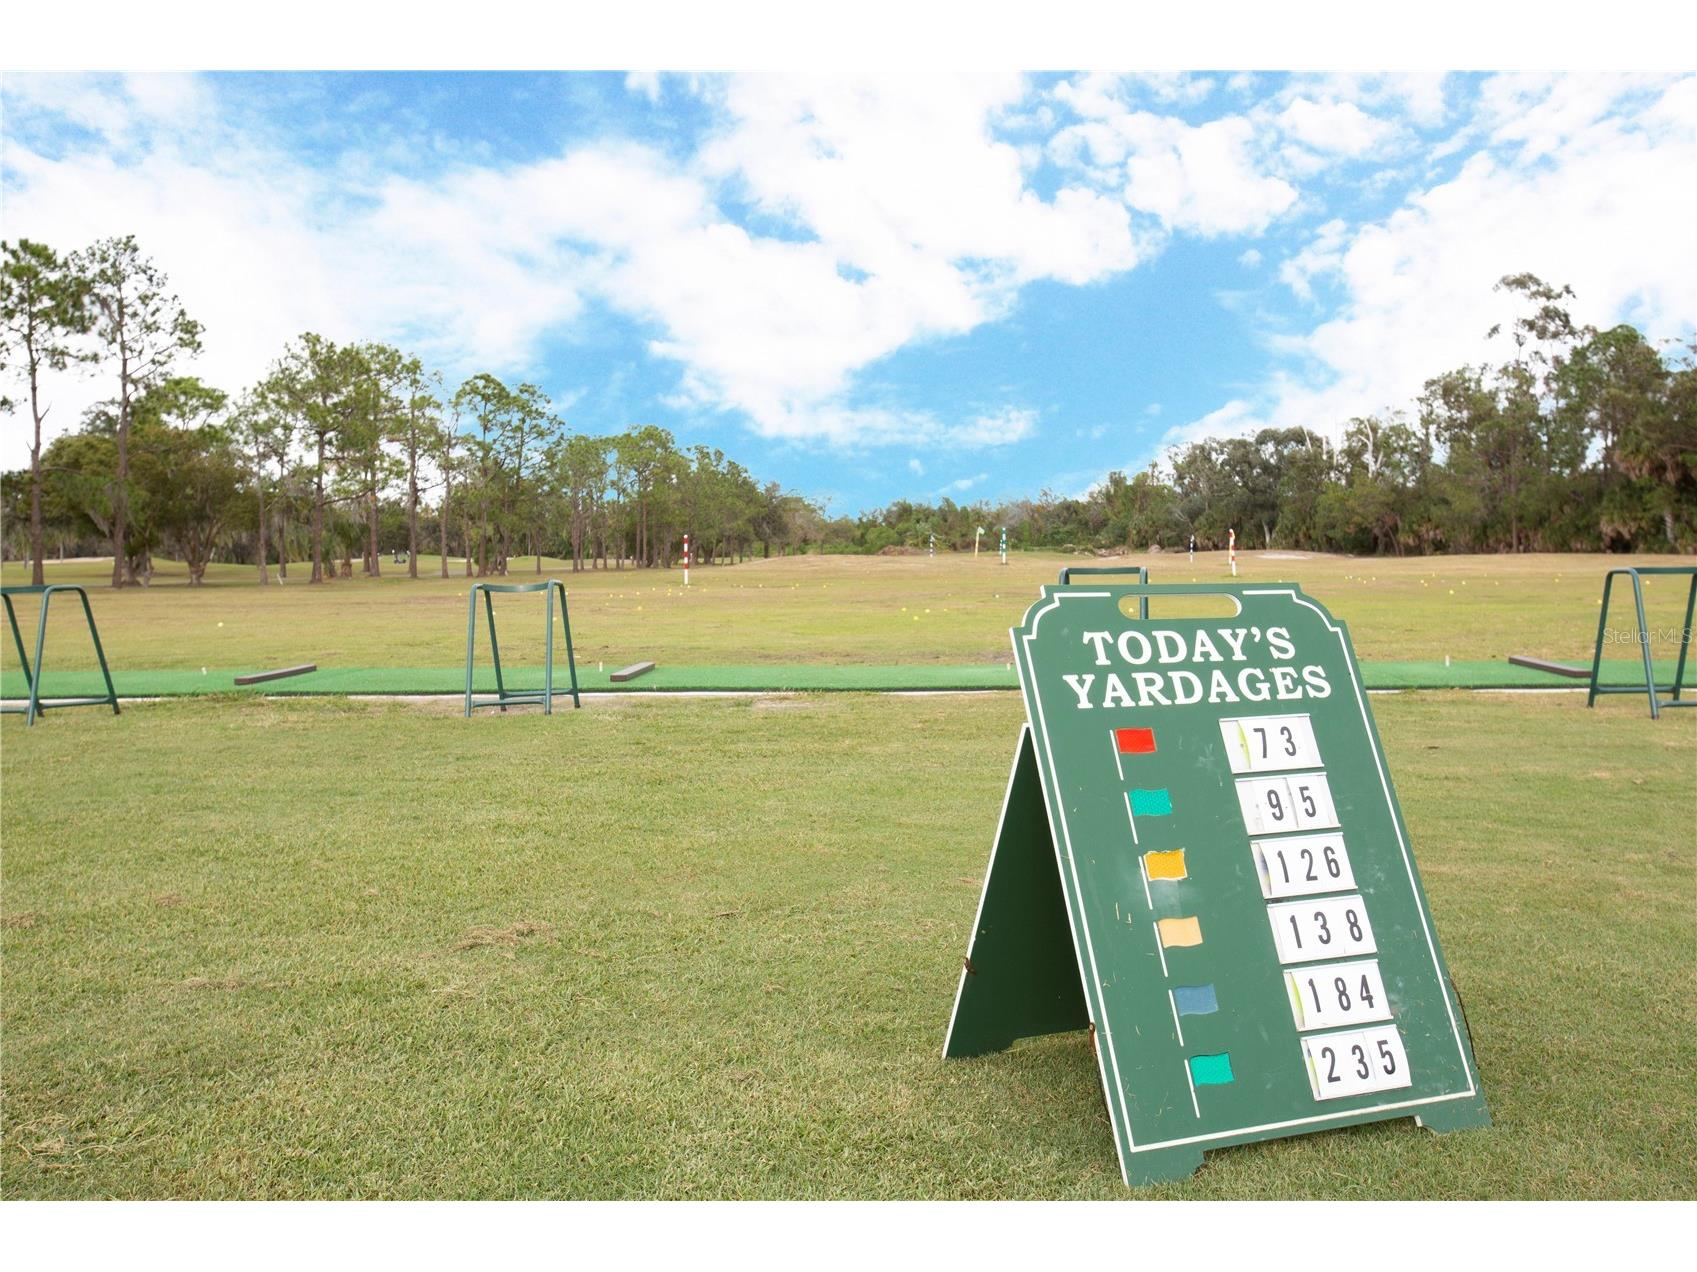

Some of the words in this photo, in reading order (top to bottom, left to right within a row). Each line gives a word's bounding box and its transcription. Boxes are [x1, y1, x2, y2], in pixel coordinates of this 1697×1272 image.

[1082, 627, 1297, 666] TODAY'S
[1063, 665, 1332, 710] YARDAGES
[1253, 726, 1298, 759] 73
[1267, 785, 1317, 822] 95
[1277, 846, 1341, 883] 126
[1290, 909, 1364, 949] 138
[1309, 974, 1375, 1013] 184
[1321, 1039, 1397, 1084] 235
